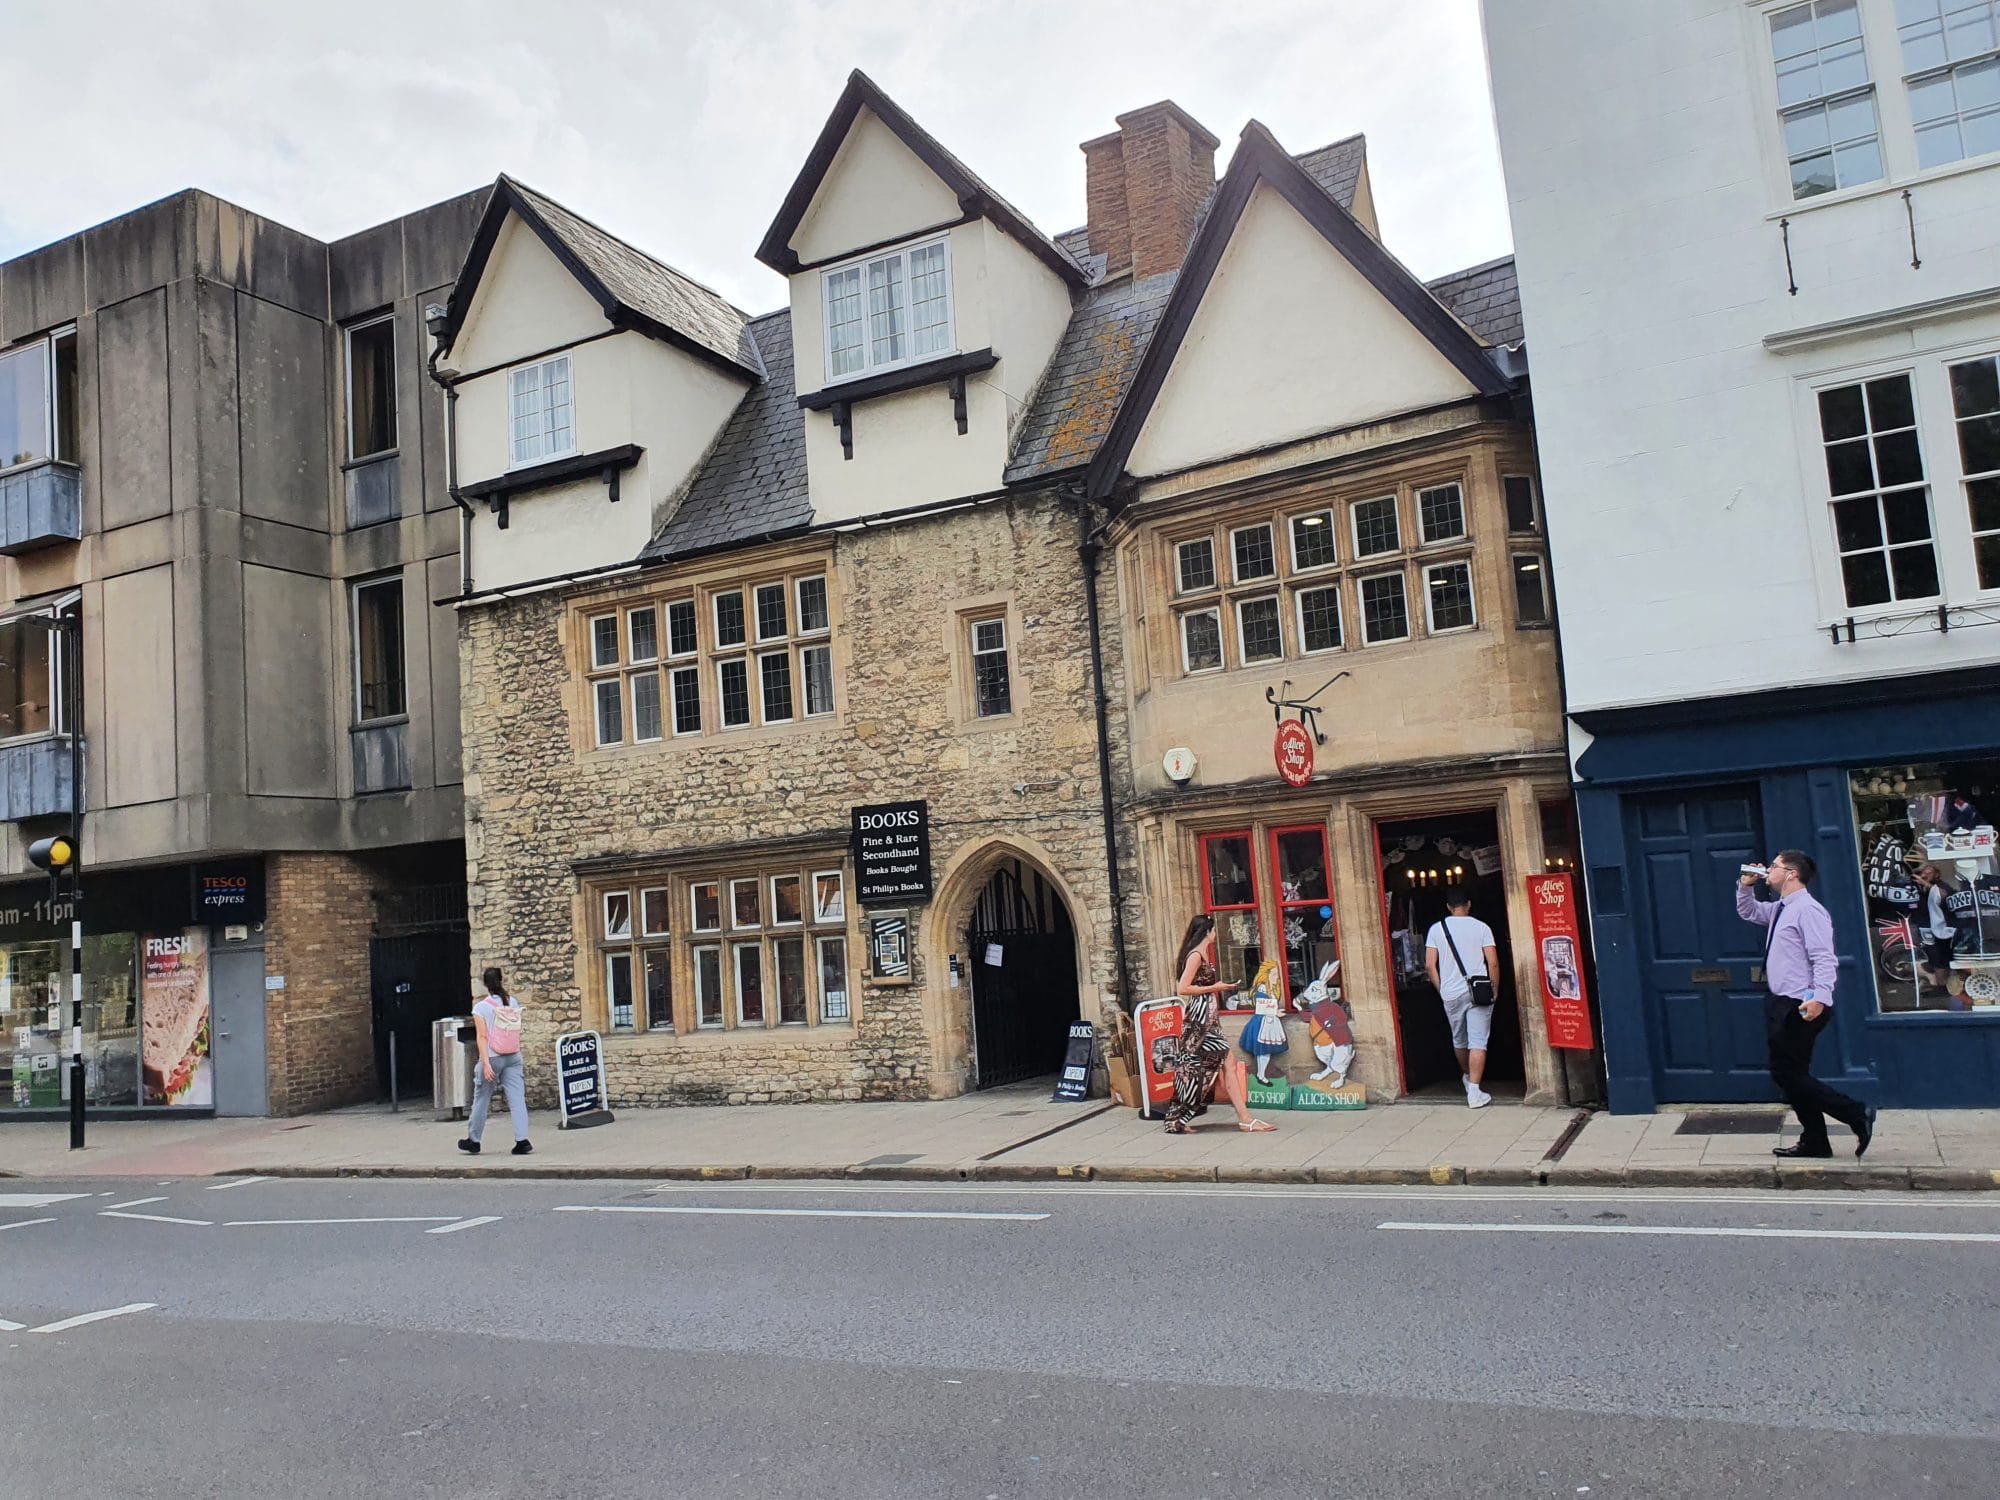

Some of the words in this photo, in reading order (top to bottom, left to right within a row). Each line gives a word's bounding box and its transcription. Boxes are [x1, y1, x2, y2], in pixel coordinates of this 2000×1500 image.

[1285, 748, 1304, 769] Shop
[859, 810, 920, 830] BOOKS
[862, 837, 883, 847] Fine
[885, 835, 893, 845] &
[896, 834, 919, 844] Rare
[862, 846, 920, 860] Secondhand
[866, 866, 889, 875] Books
[890, 864, 918, 874] Bought
[203, 877, 246, 887] TESCO
[862, 886, 871, 894] St
[900, 882, 924, 891] Books
[204, 895, 245, 907] express
[1539, 890, 1565, 908] Shop
[146, 936, 192, 957] FRESH
[1152, 1019, 1174, 1031] Shop
[1069, 1026, 1093, 1038] BOOKS
[561, 1040, 596, 1056] BOOKS
[568, 1058, 584, 1067] RARE
[571, 1080, 592, 1093] OPEN
[1248, 1091, 1264, 1103] ICE'S
[1266, 1092, 1286, 1104] SHOP
[1298, 1092, 1332, 1105] ALICE'S
[1335, 1092, 1360, 1105] SHOP
